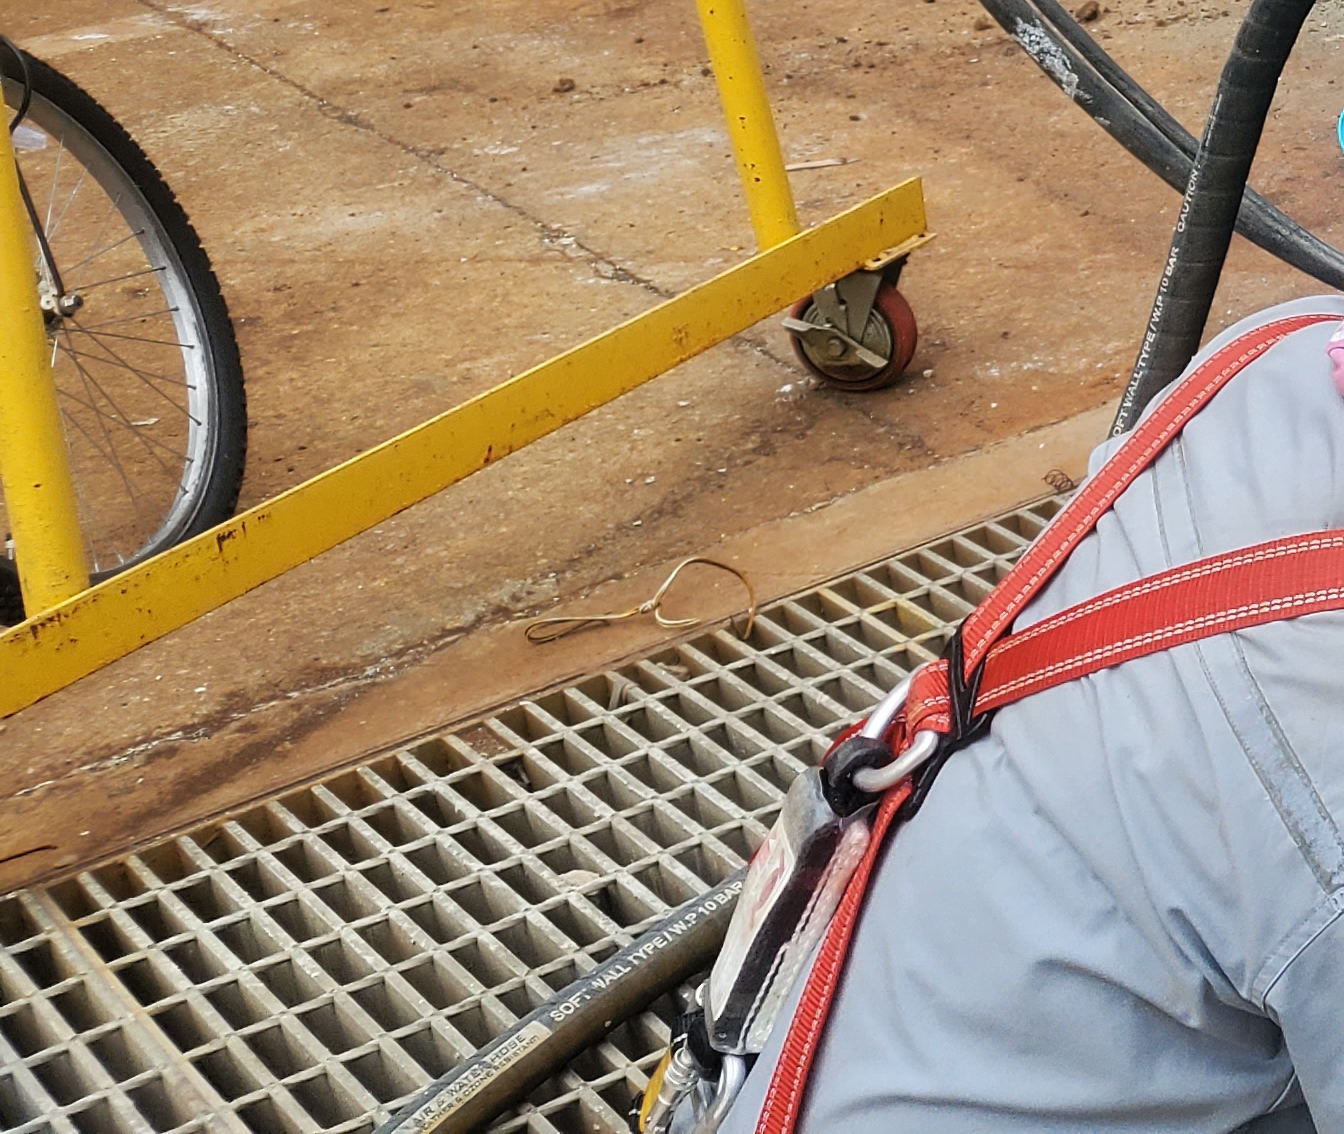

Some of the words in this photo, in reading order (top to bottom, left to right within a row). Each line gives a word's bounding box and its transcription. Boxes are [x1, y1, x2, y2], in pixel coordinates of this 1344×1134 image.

[1123, 368, 1143, 409] WALL
[1138, 332, 1156, 368] TYPE
[1160, 277, 1169, 293] 10
[1165, 246, 1180, 278] BAR
[698, 901, 717, 915] 10
[714, 881, 743, 905] BAR
[411, 1106, 434, 1125] AIR
[491, 1034, 526, 1063] HOSE
[463, 1070, 494, 1097] OZONE
